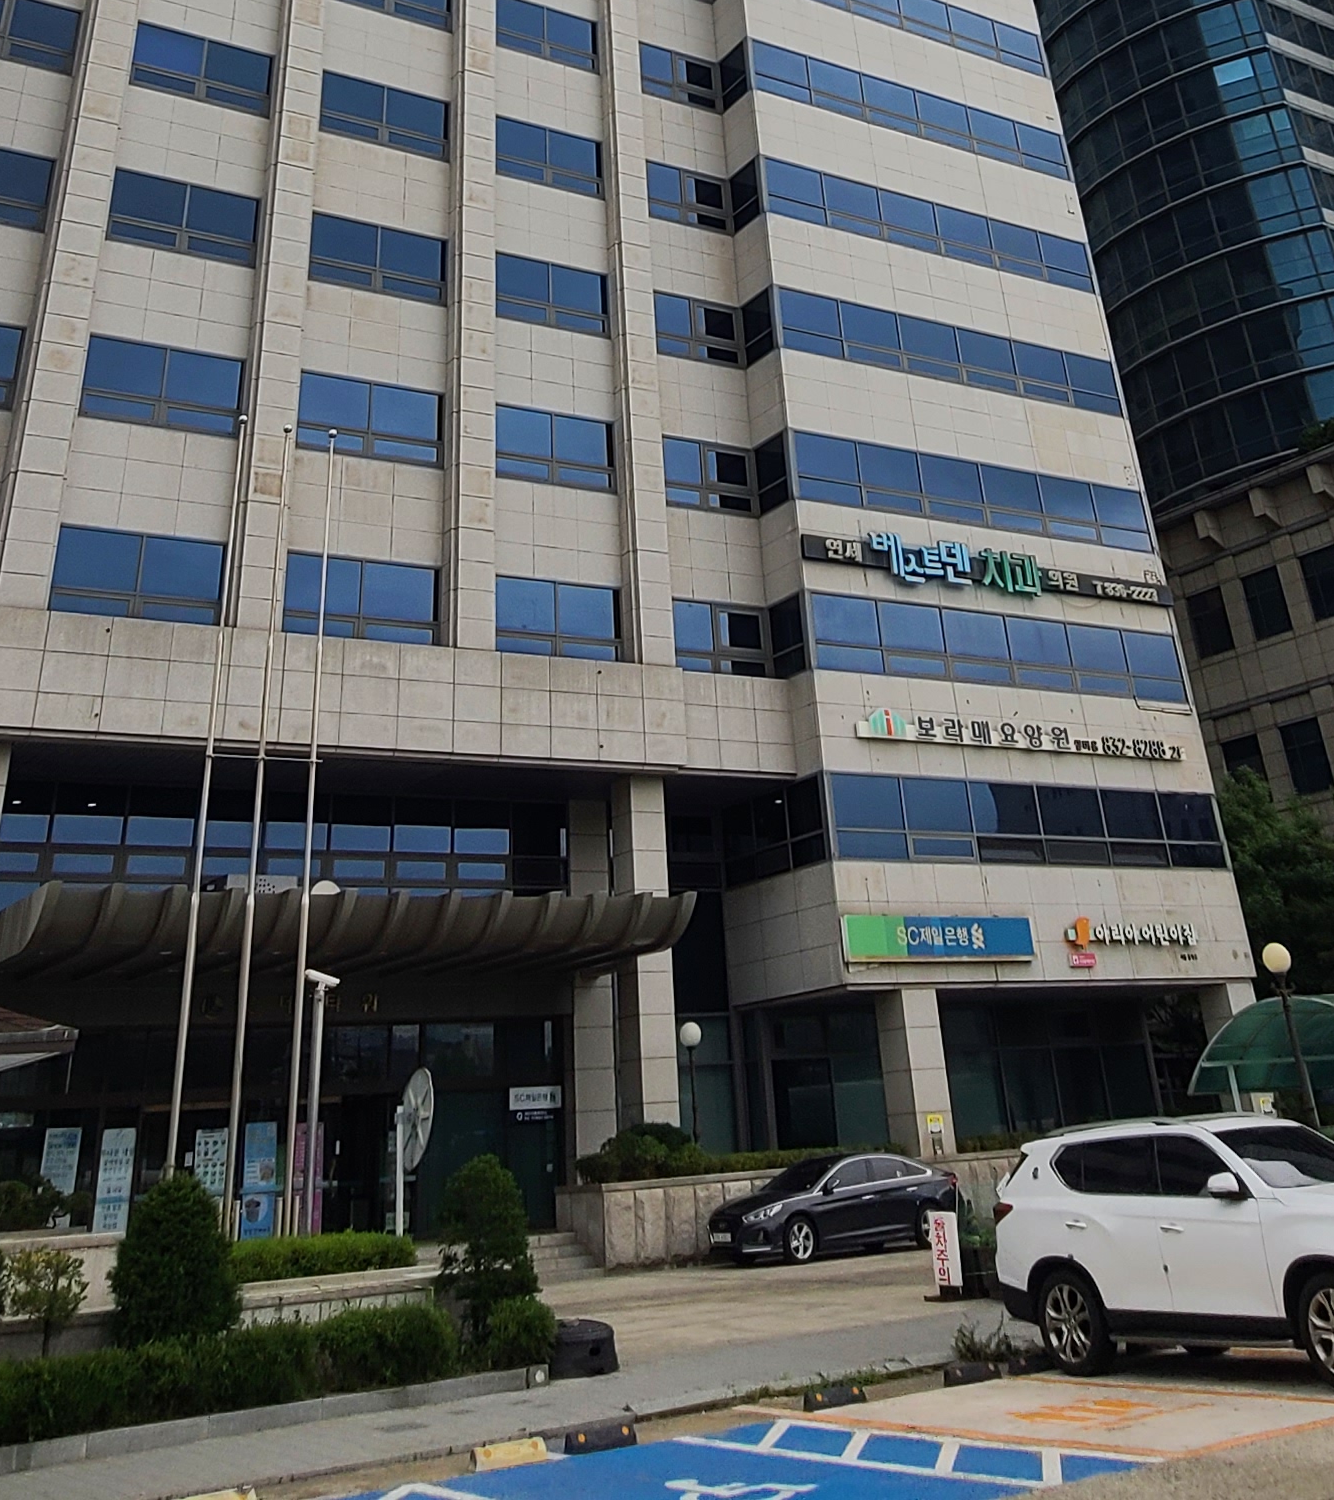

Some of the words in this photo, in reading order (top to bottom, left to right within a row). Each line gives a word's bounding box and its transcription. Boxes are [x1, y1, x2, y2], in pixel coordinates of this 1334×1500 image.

[825, 538, 863, 562] 연세
[867, 531, 973, 586] 베스트덴
[979, 548, 1043, 597] 치과
[1048, 570, 1079, 592] 의원
[916, 715, 1071, 750] 보라매요양원
[896, 925, 970, 947] SC제일은행
